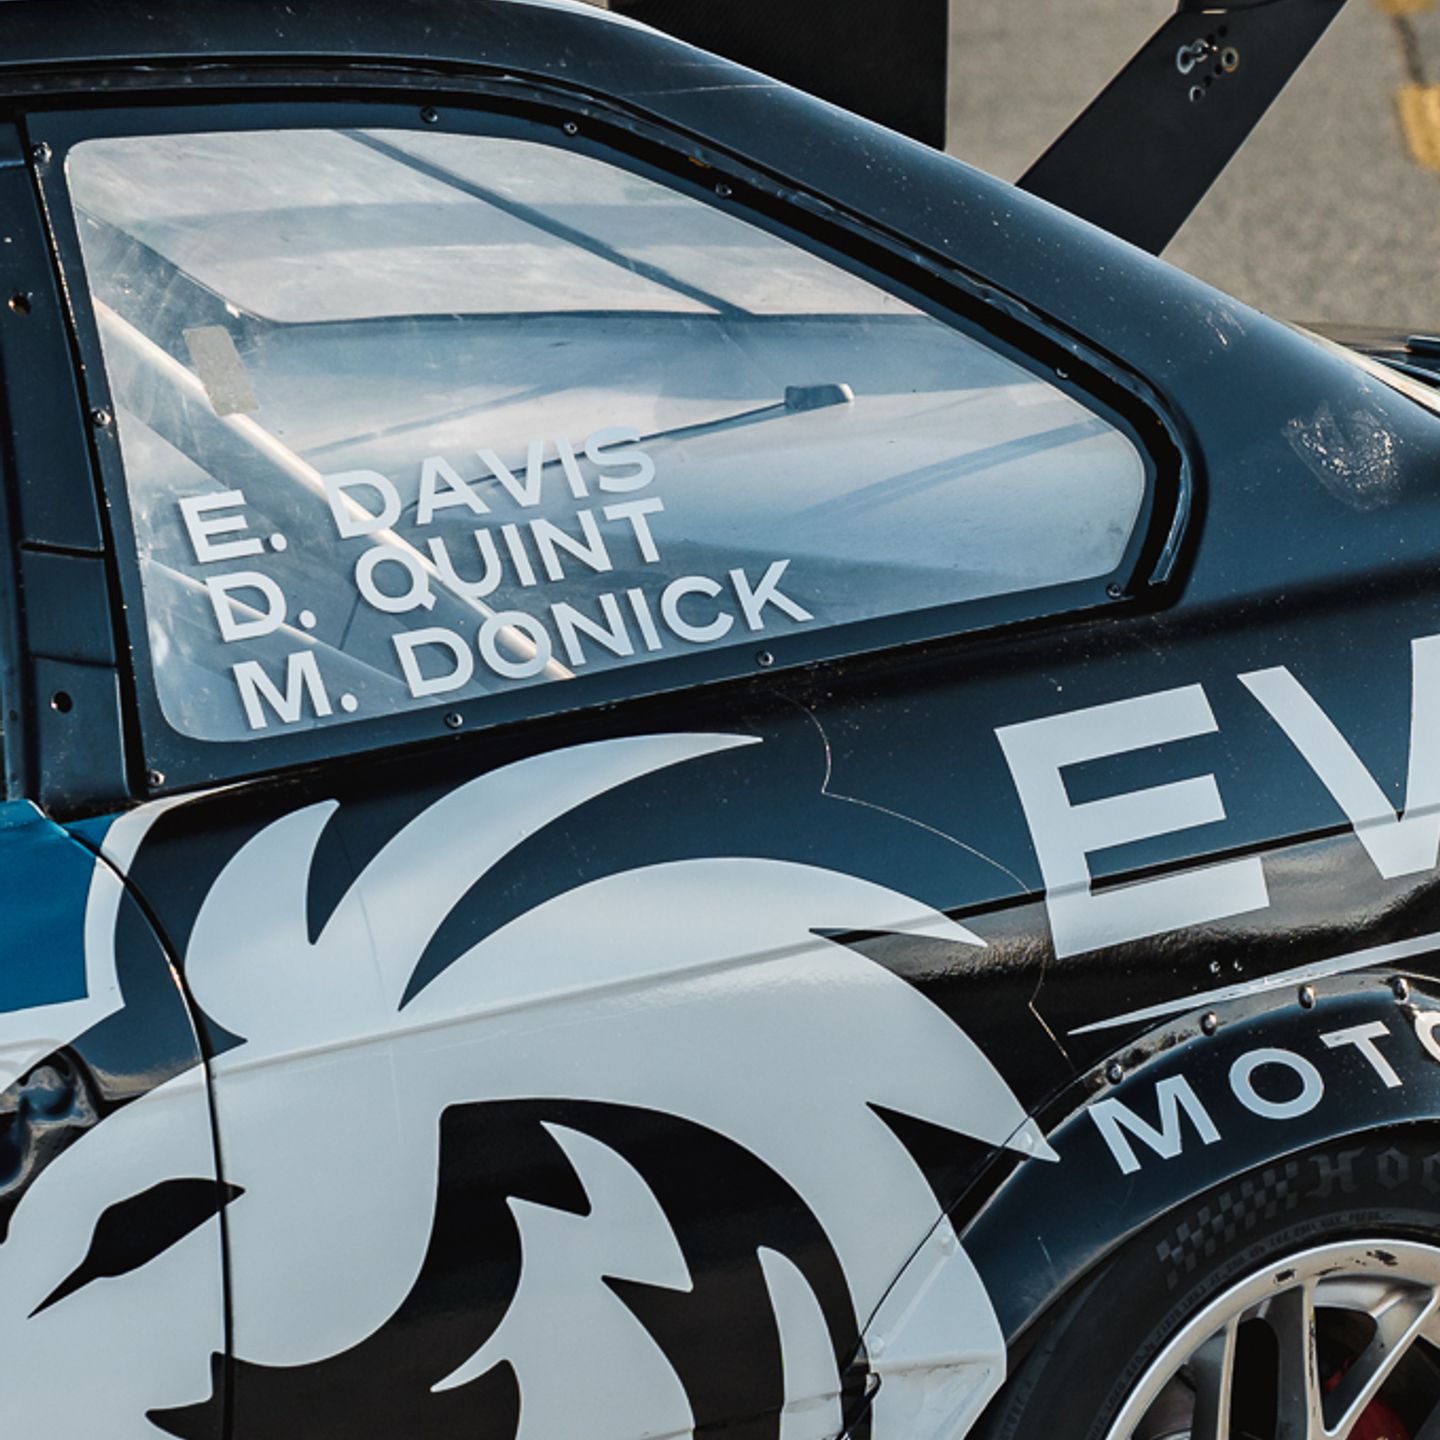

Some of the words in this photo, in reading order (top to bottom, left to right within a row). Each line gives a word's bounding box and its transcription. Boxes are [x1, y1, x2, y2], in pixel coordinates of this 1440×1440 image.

[178, 489, 288, 563] E.
[320, 426, 657, 540] DAVIS
[205, 571, 317, 643] D.
[354, 496, 666, 615] QUINT
[231, 650, 358, 731] M.
[391, 559, 815, 699] DONICK
